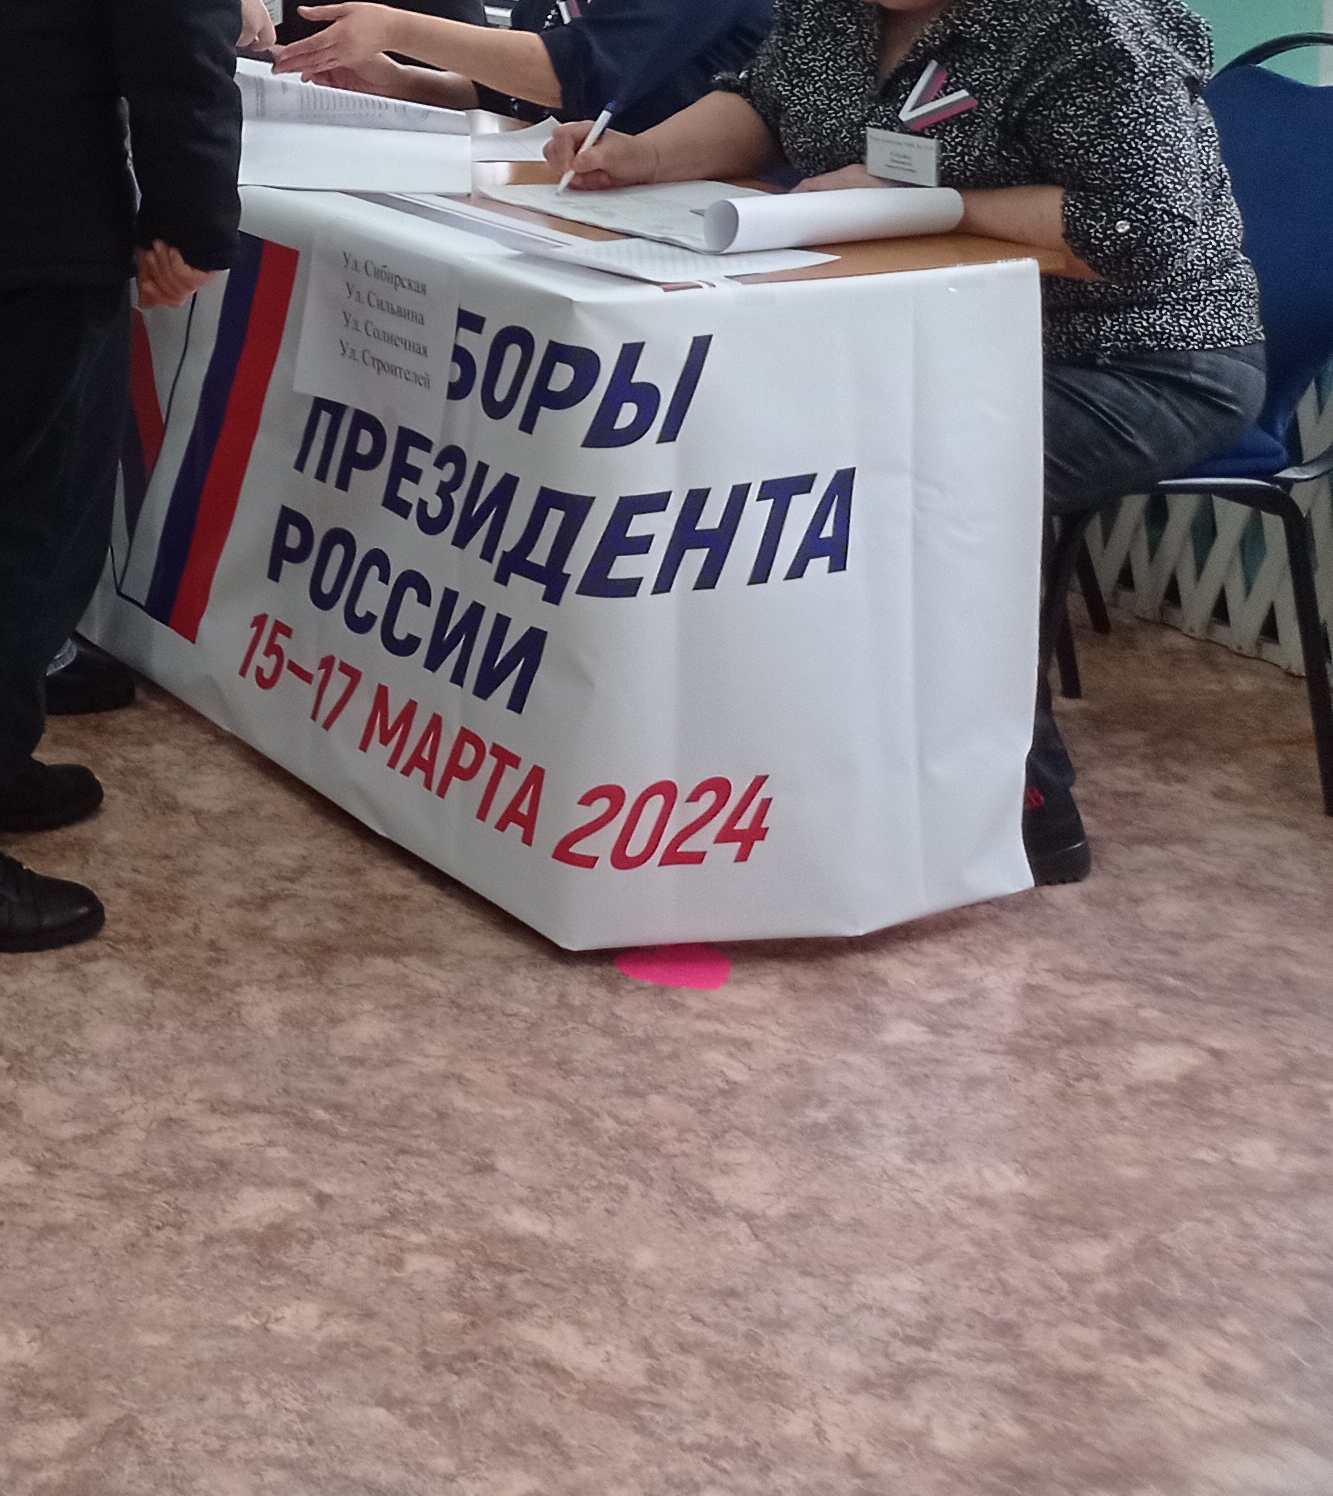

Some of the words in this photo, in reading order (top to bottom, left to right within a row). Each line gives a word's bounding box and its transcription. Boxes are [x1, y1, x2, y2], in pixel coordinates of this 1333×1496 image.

[343, 251, 361, 273] Ул.
[364, 259, 427, 296] Сибирская
[345, 281, 363, 304] Ул.
[339, 338, 359, 362] Ул.
[362, 349, 431, 390] Строителей
[342, 310, 362, 333] Ул.
[364, 319, 428, 358] Солнечная
[445, 307, 714, 450] БОРЫ
[293, 395, 857, 607] ПРЕЗИДЕНТА
[267, 504, 549, 716] РОССИИ
[358, 682, 546, 848] МАРТА
[551, 774, 774, 871] 2024
